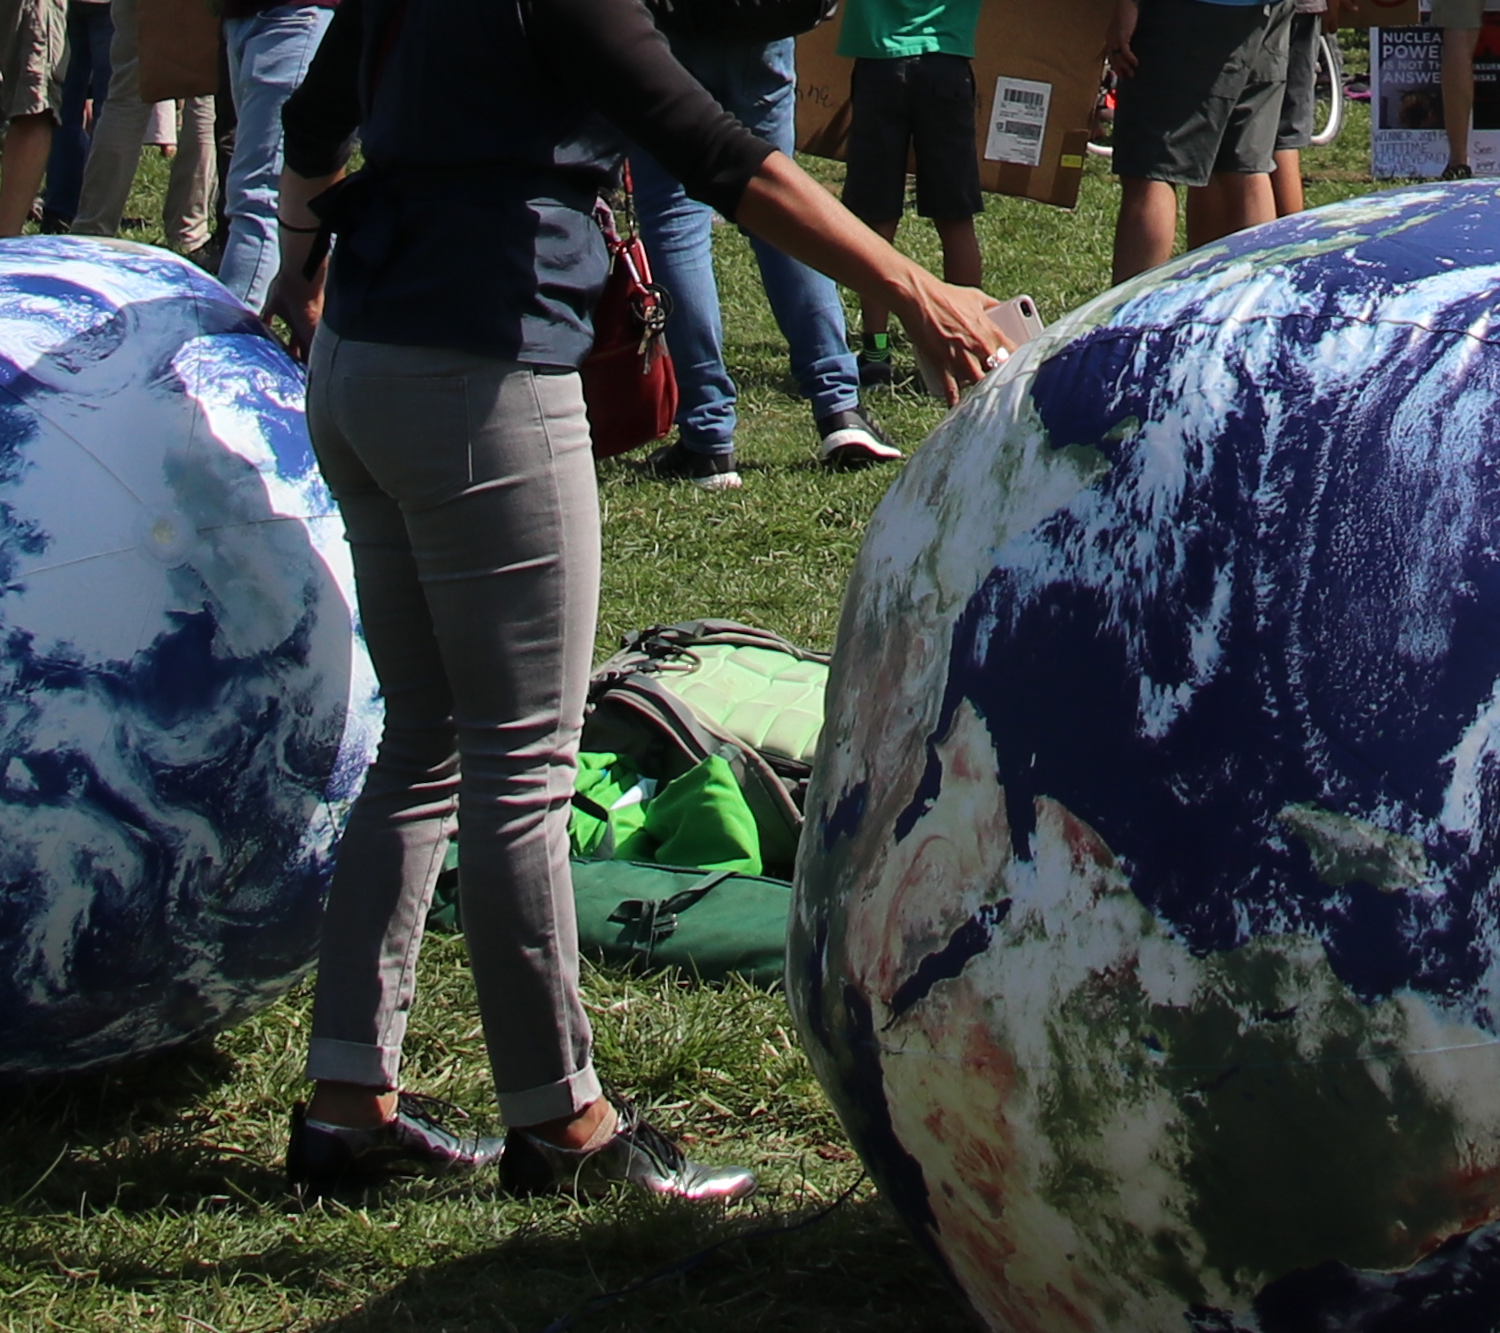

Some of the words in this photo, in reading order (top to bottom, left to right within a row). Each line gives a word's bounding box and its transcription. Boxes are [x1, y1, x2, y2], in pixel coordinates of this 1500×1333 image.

[1383, 32, 1442, 44] NUCLEA
[1383, 45, 1443, 59] POWE
[1383, 61, 1395, 70] IS
[1399, 60, 1424, 70] NOT
[1382, 71, 1442, 83] ANSWE
[1374, 142, 1428, 154] LIFETIME
[1374, 153, 1448, 164] ACHIEVEMEN
